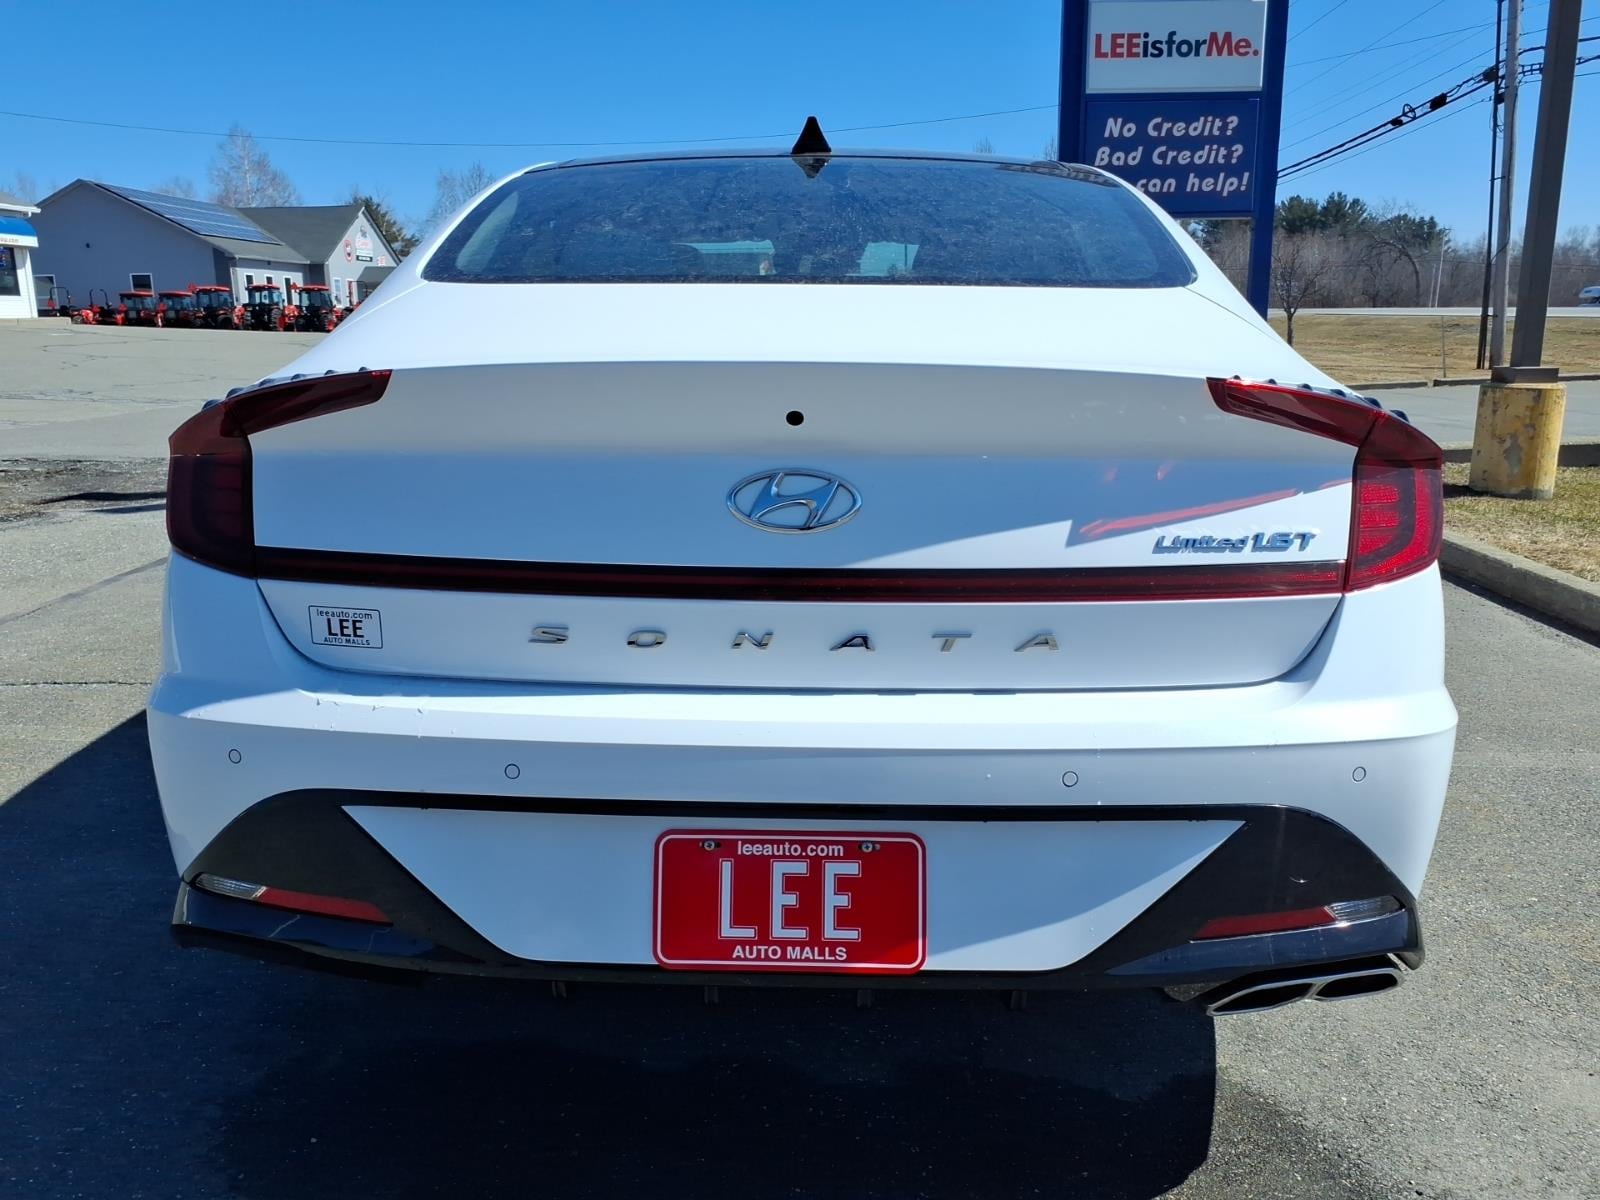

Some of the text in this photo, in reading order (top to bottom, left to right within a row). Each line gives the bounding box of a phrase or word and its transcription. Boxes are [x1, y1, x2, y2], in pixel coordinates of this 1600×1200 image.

[1104, 116, 1239, 138] No Credit?
[1094, 144, 1243, 166] Bad Credit?
[1136, 172, 1249, 197] can help!
[1152, 535, 1249, 554] Limited
[316, 608, 373, 620] leeauto.com
[327, 618, 364, 638] LEE
[528, 624, 1060, 652] SONATA
[344, 638, 371, 646] MALLS
[737, 841, 844, 857] leeauto.com
[718, 858, 862, 942] LEE
[732, 945, 847, 961] AUTO MALLS
